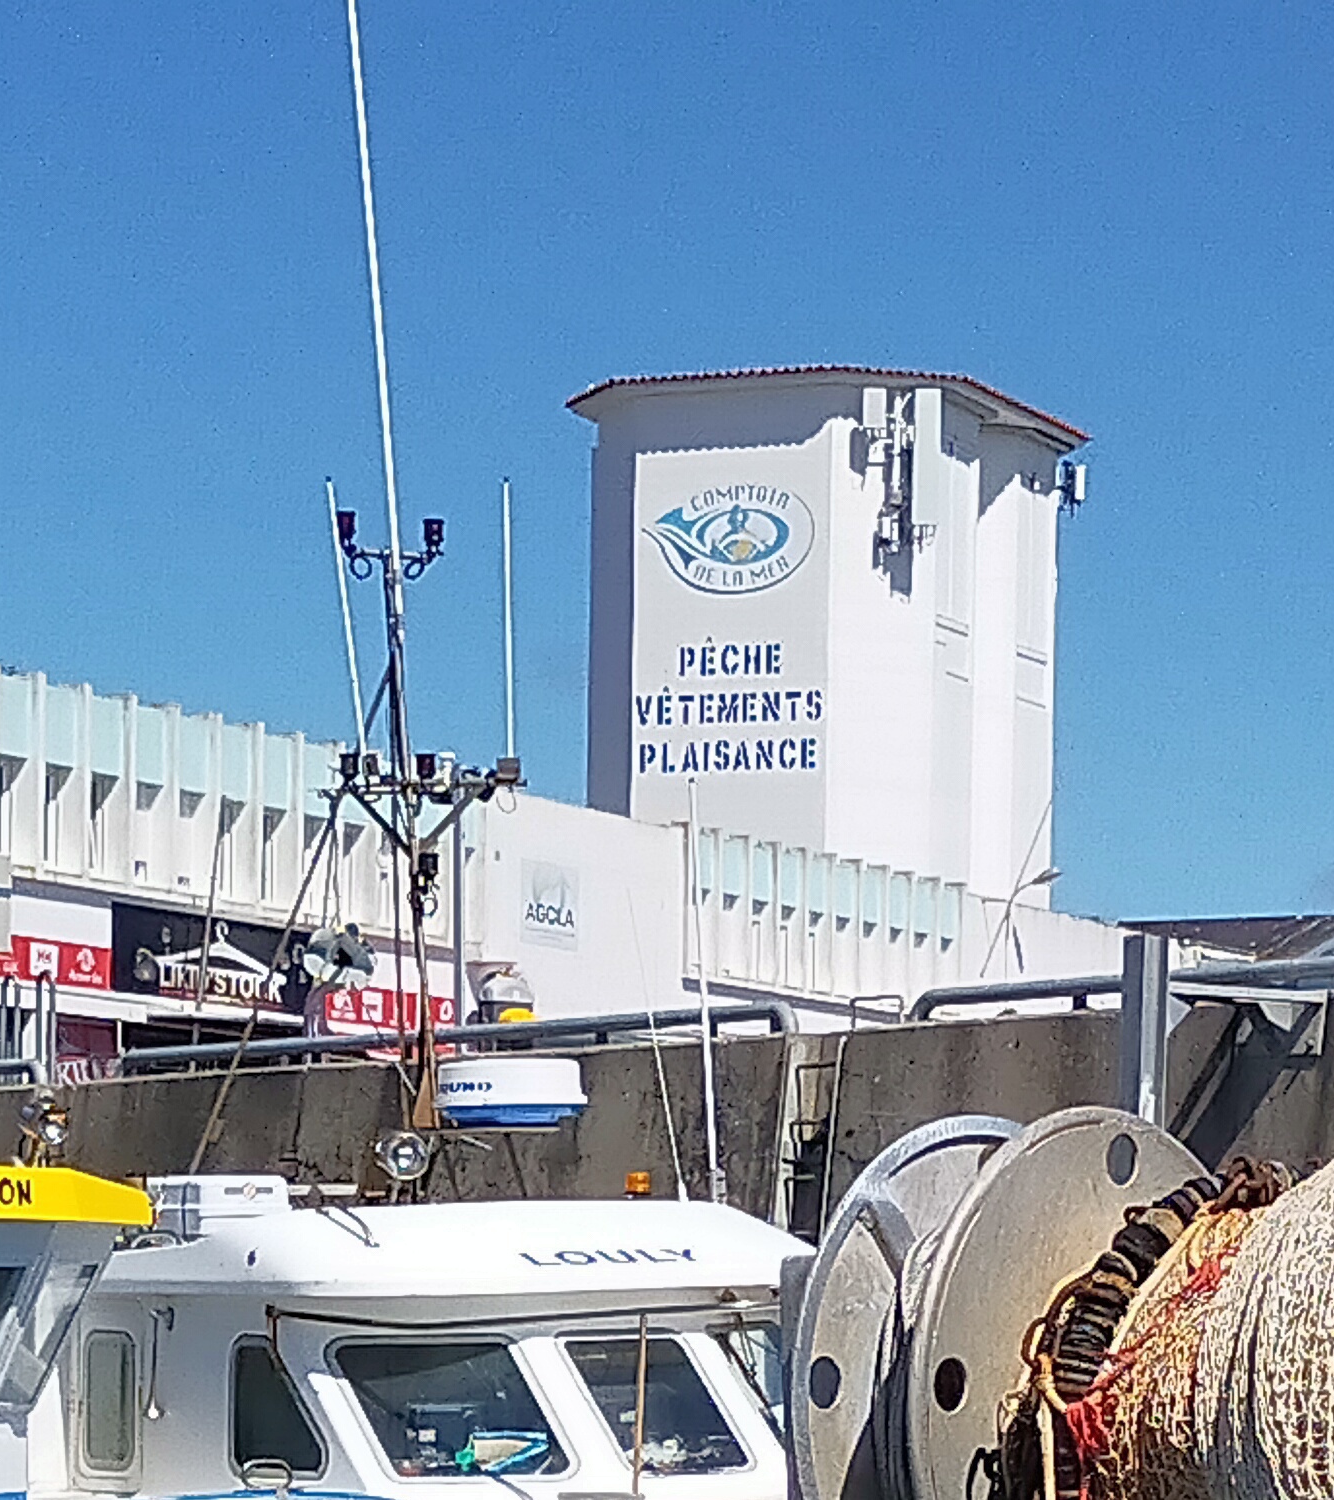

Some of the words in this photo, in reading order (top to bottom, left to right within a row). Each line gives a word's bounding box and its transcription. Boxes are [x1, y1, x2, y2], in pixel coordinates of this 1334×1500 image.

[690, 484, 790, 512] COMPTOIR
[693, 564, 716, 585] DE
[722, 570, 744, 587] LA
[749, 555, 789, 585] MER
[678, 636, 781, 677] PÊCHE
[636, 686, 823, 726] VÊTEMENTS
[638, 738, 817, 774] PLAISANCE
[518, 1248, 697, 1267] LOULY
